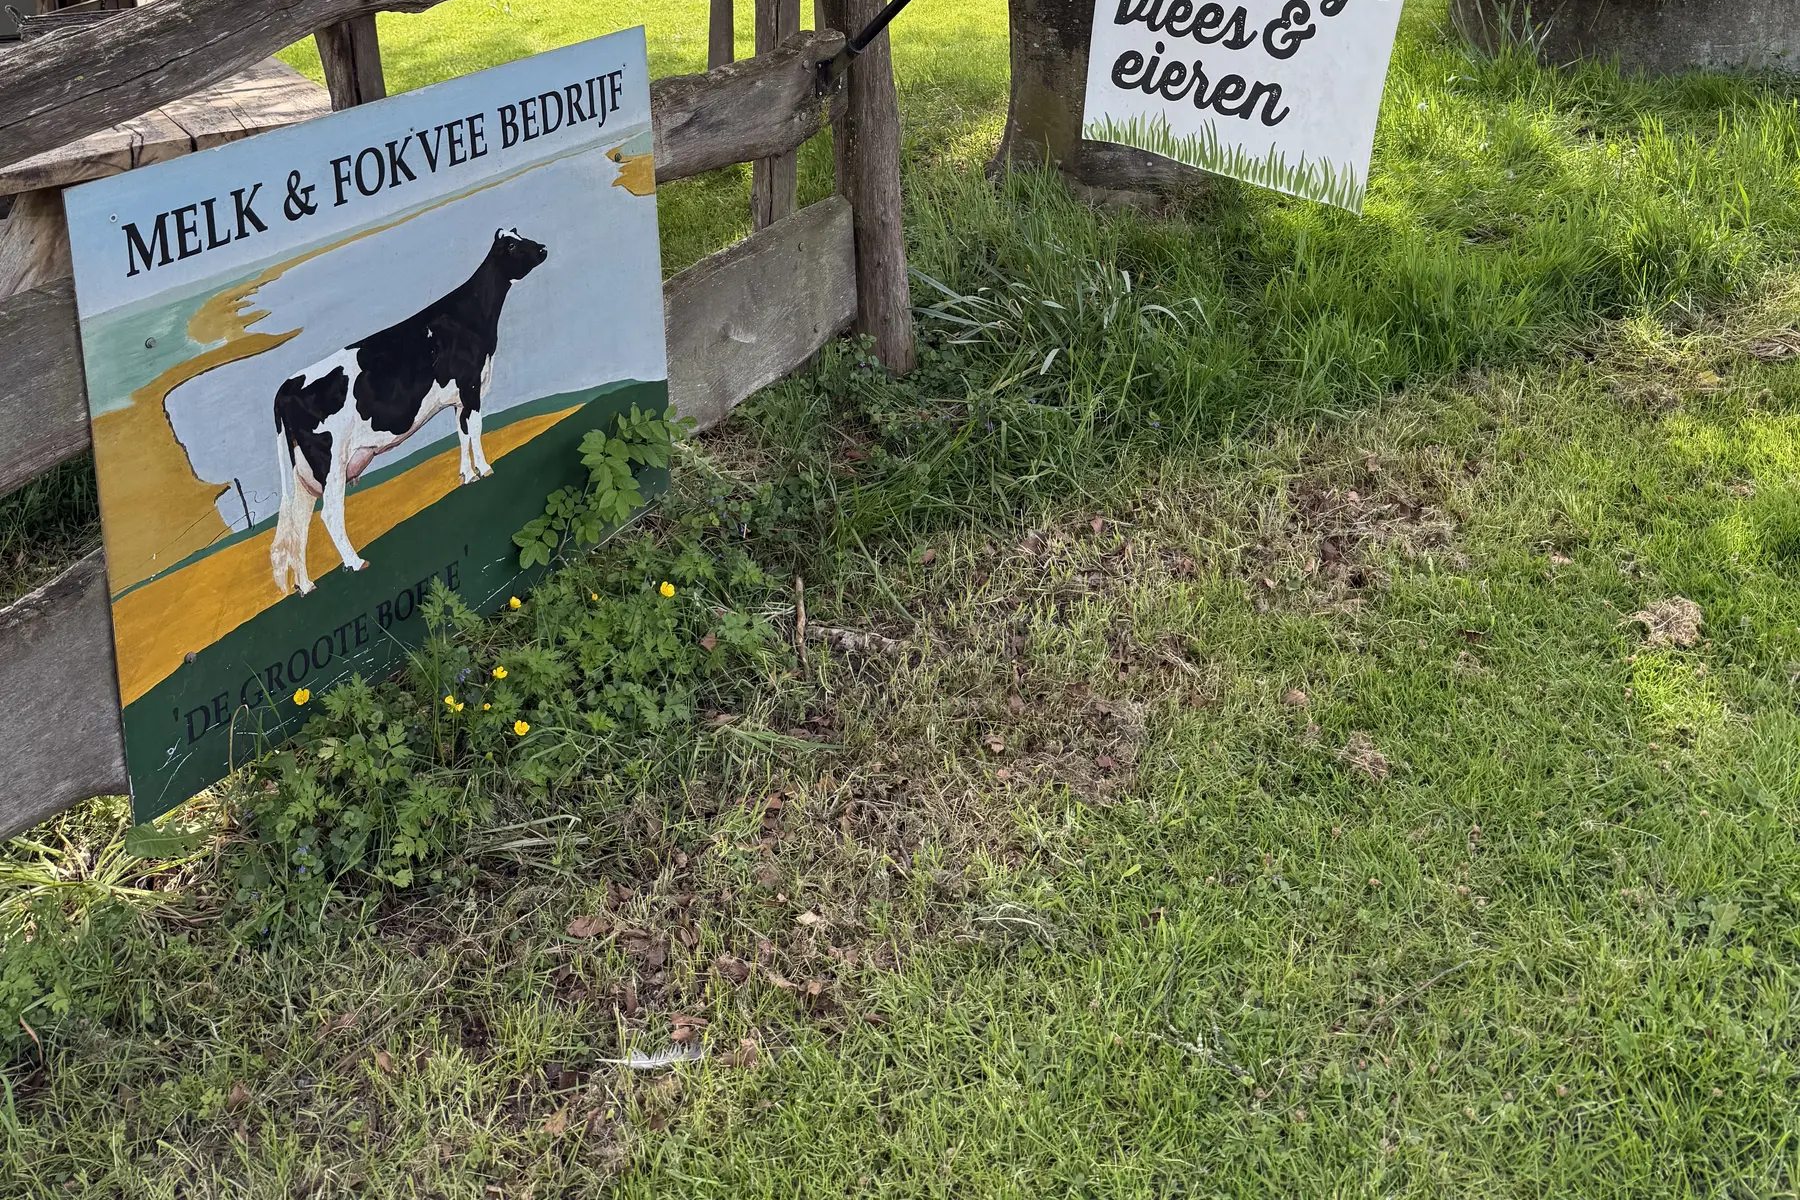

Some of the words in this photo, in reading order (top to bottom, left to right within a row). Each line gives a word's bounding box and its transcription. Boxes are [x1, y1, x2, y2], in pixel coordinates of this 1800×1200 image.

[1111, 41, 1290, 127] eieren
[121, 182, 268, 278] MELK
[283, 169, 318, 221] &
[329, 112, 488, 207] FOKVEE
[497, 70, 623, 150] BEDRIJF
[240, 612, 370, 710] GROOTE
